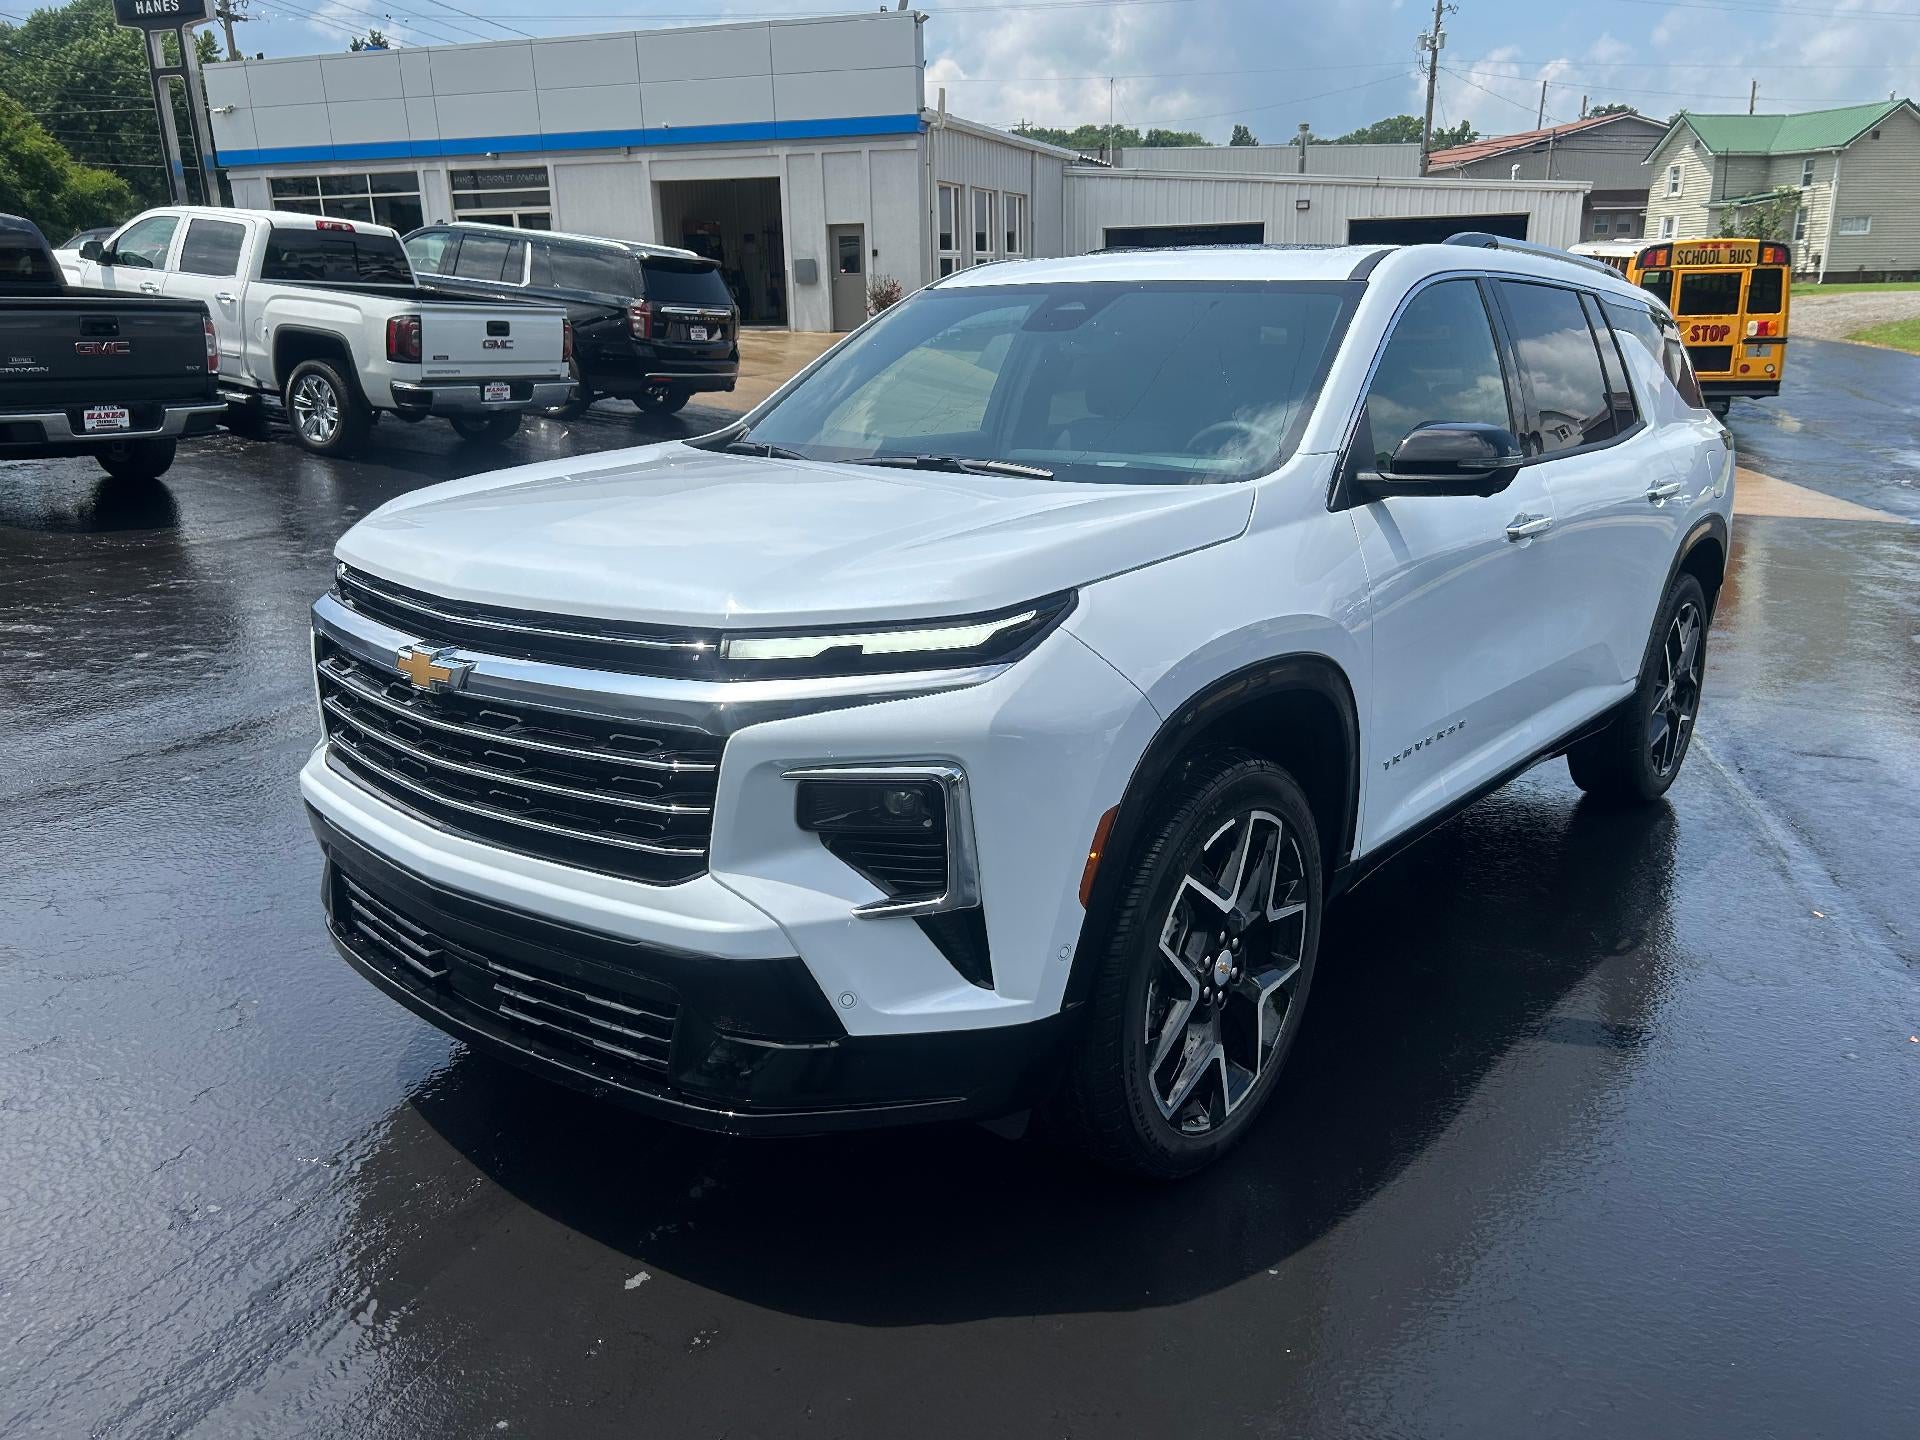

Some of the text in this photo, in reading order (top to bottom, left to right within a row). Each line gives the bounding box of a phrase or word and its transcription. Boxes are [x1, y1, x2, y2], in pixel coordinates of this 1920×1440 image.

[135, 0, 180, 15] HANES
[477, 174, 513, 185] CHEVROLET
[517, 173, 546, 183] COMPANY
[1677, 248, 1752, 265] SCHOOL BUS
[1689, 324, 1731, 343] STOP
[75, 341, 130, 355] GMC
[482, 339, 514, 350] GMC
[86, 411, 126, 420] HANES
[1382, 719, 1467, 771] TRAVERSE
